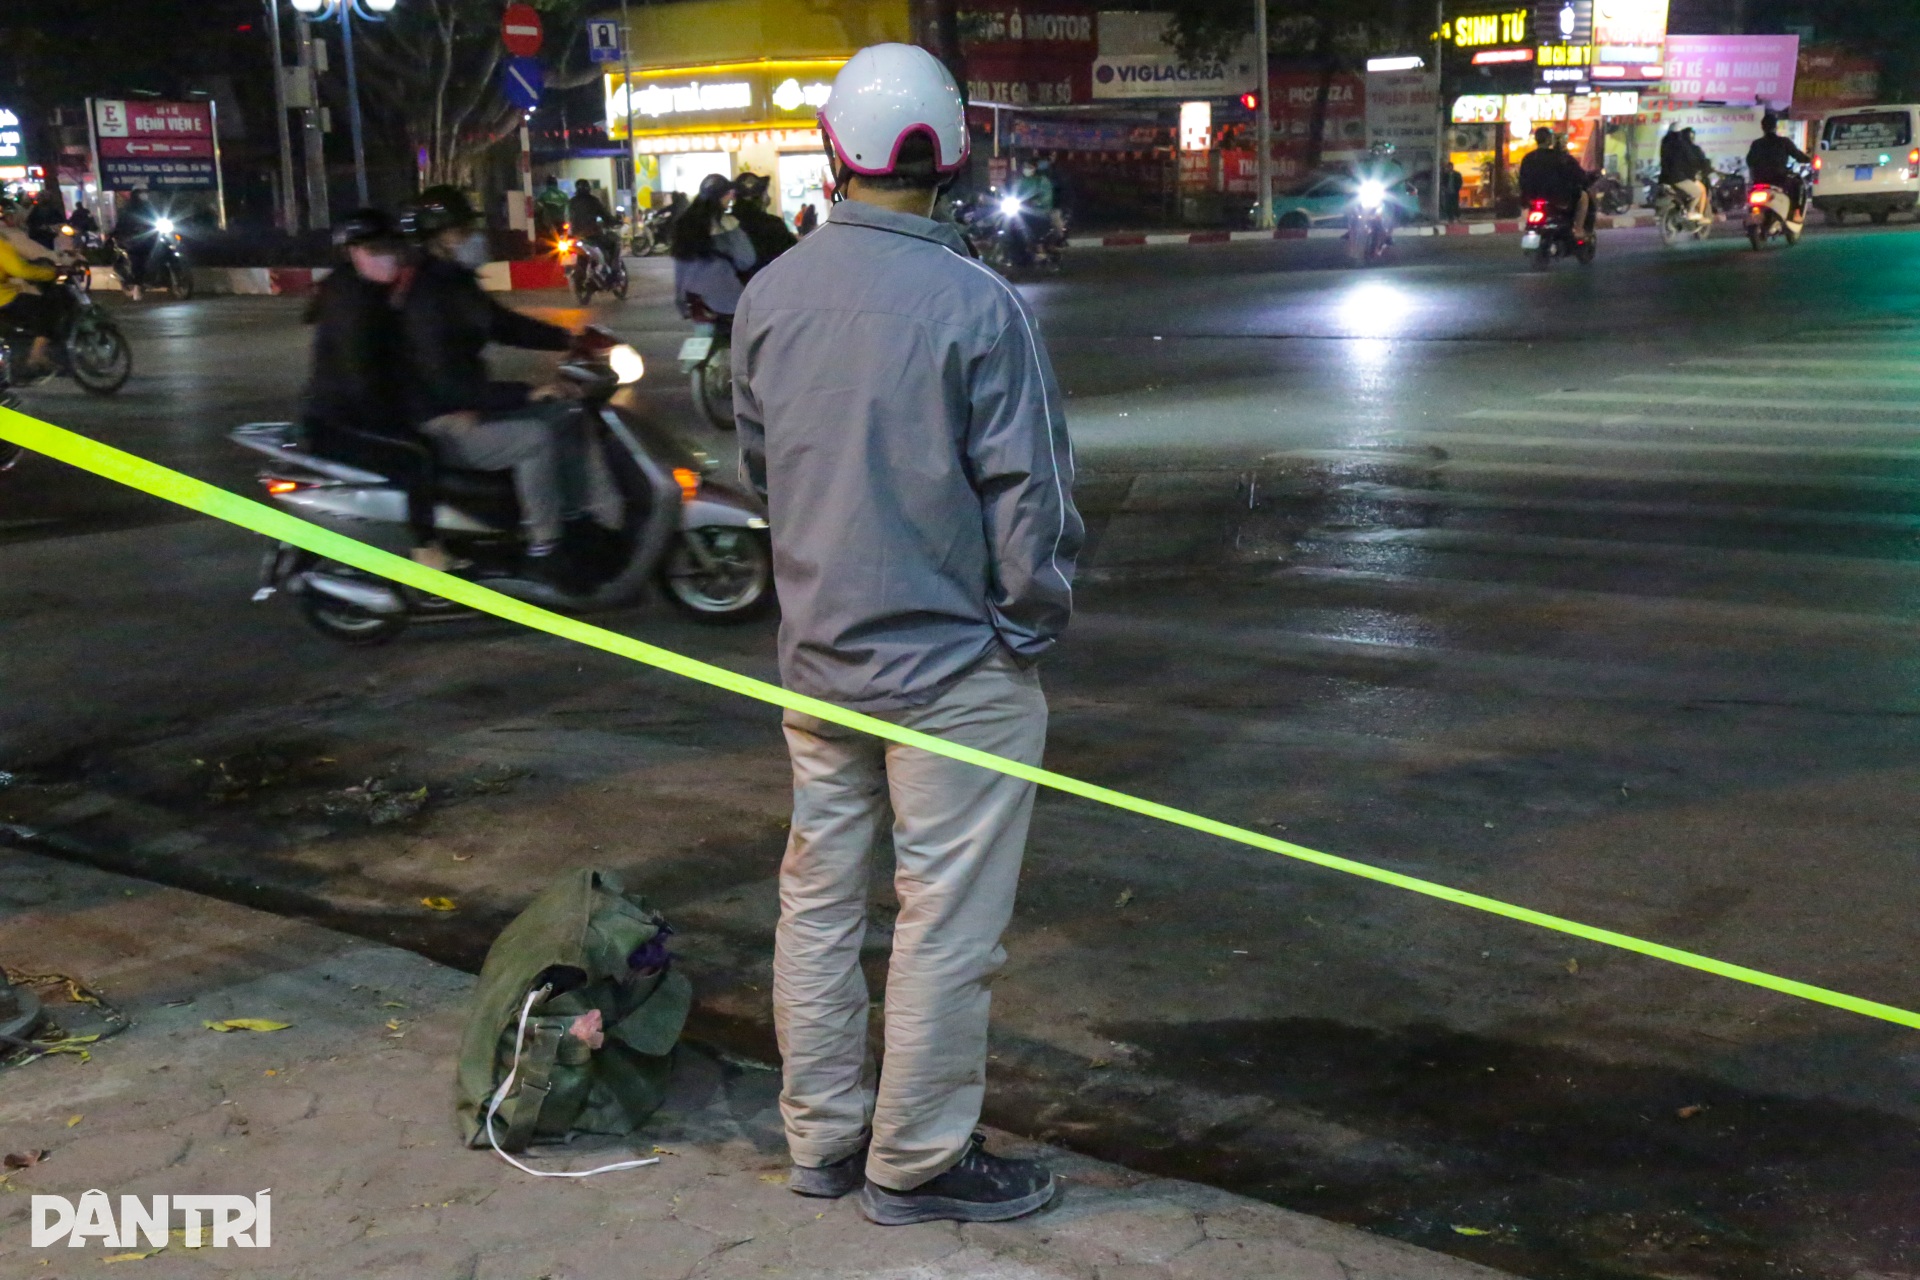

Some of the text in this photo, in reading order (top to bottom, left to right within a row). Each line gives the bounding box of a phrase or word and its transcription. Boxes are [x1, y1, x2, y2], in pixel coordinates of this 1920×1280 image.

[1025, 15, 1091, 41] MOTOR
[1455, 16, 1498, 47] SINH
[1117, 63, 1225, 82] VIGLACERA
[1663, 57, 1682, 78] IẾT
[1687, 56, 1703, 78] KẾ
[1715, 62, 1730, 78] IN
[1733, 61, 1780, 78] NHANH
[1657, 79, 1700, 95] HOTO
[1705, 80, 1727, 95] A4
[103, 105, 119, 122] E
[135, 114, 203, 133] BỆNH VIỆN E
